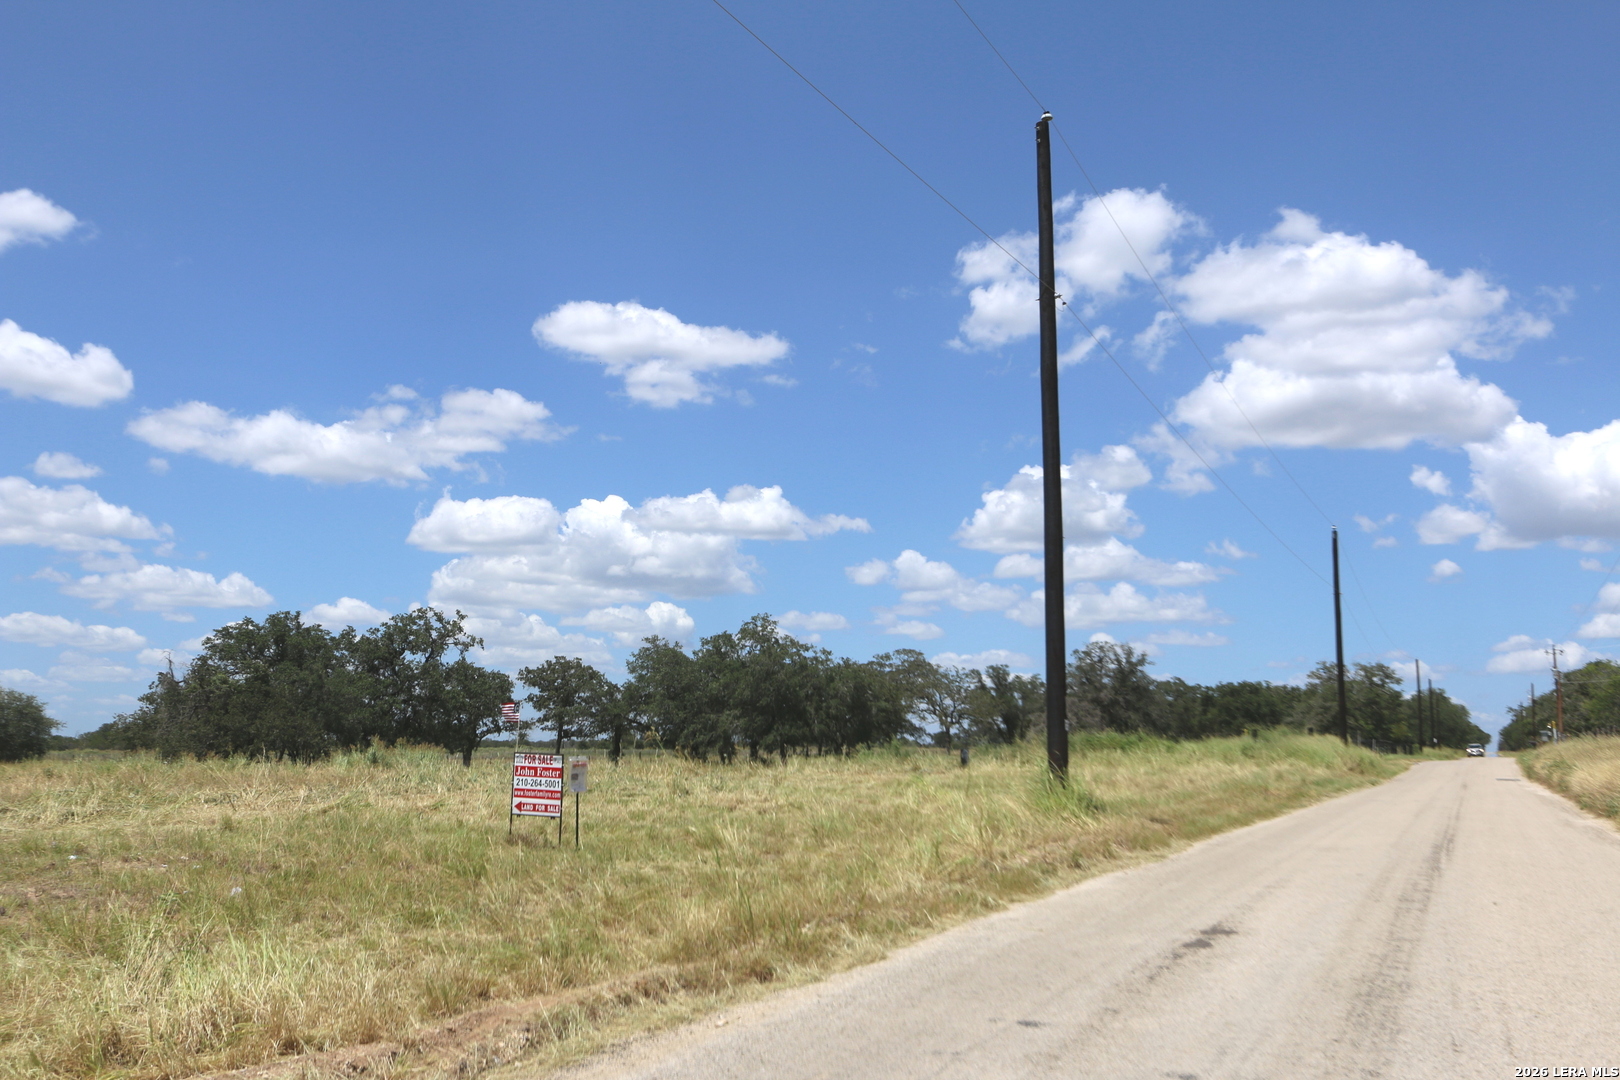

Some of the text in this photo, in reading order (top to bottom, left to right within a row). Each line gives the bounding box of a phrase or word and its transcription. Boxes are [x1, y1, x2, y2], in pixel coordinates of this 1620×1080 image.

[524, 754, 554, 766] FOR SALE
[516, 767, 560, 778] John Foster
[516, 778, 560, 788] 210-264-5001
